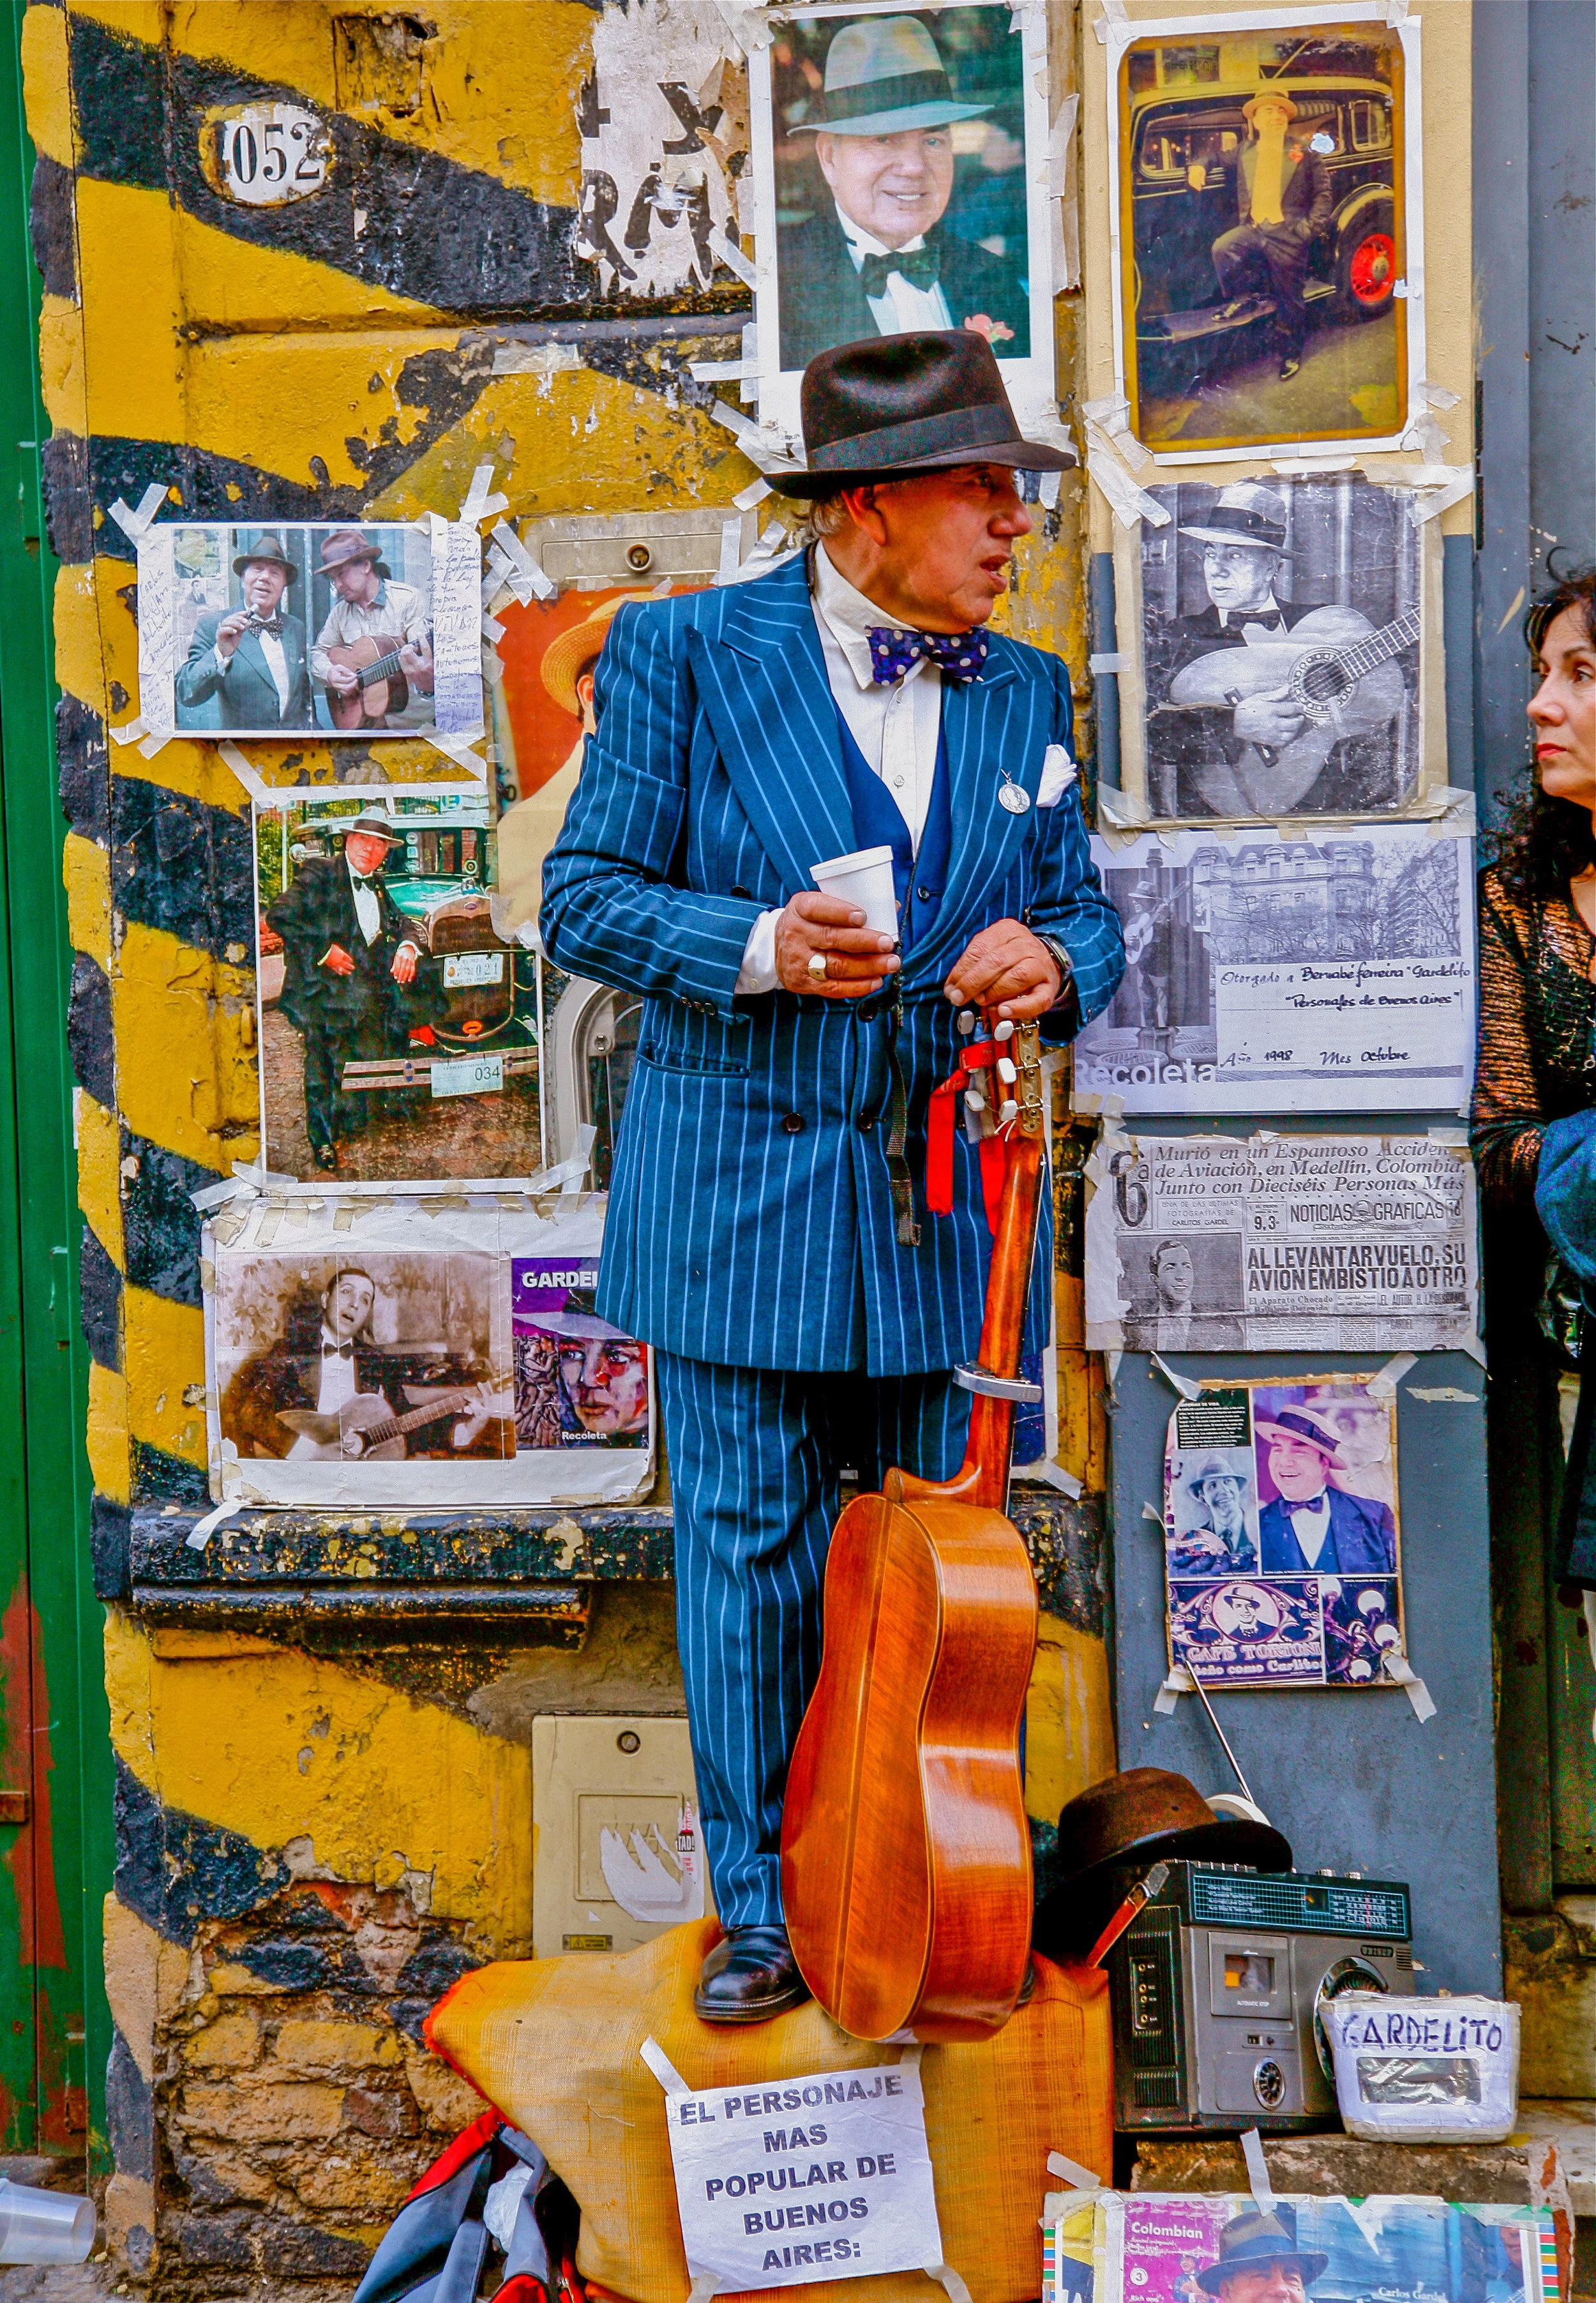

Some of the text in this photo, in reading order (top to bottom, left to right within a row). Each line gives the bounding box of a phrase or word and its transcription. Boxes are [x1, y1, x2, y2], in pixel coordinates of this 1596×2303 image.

[232, 121, 320, 185] 052
[1359, 994, 1376, 1006] de
[1263, 1050, 1293, 1062] 1998
[1320, 1051, 1351, 1066] Mes
[474, 1066, 501, 1082] 034
[1074, 1057, 1218, 1085] Recoleta
[1155, 1146, 1210, 1161] Murió
[1219, 1150, 1240, 1159] en
[1246, 1148, 1269, 1159] un
[1276, 1143, 1369, 1161] Espantoso
[1155, 1164, 1175, 1178] de
[1178, 1162, 1263, 1179] Aviación,
[1266, 1165, 1284, 1176] en
[1376, 1158, 1465, 1175] Colombia,
[1155, 1180, 1205, 1195] Junto
[1212, 1182, 1242, 1194] con
[1249, 1178, 1327, 1193] Dieciséis
[1333, 1176, 1417, 1191] Personas
[1290, 1204, 1353, 1223] NOTICIAS
[1373, 1201, 1445, 1221] GRAFICAS
[1247, 1247, 1271, 1269] AL
[1442, 1243, 1466, 1265] SU
[1260, 1297, 1295, 1306] Aparato
[1297, 1295, 1334, 1304] Chocado
[562, 1431, 606, 1440] Recoleta
[1226, 1664, 1265, 1675] como
[679, 2074, 904, 2126] EL PERSONAJE
[763, 2123, 828, 2154] MAS
[705, 2152, 896, 2201] POPULAR DE
[743, 2197, 869, 2235] BUENOS
[1131, 2222, 1203, 2240] Colombian
[762, 2238, 862, 2271] AIRES:
[1378, 2286, 1447, 2302] Carlos Gardel
